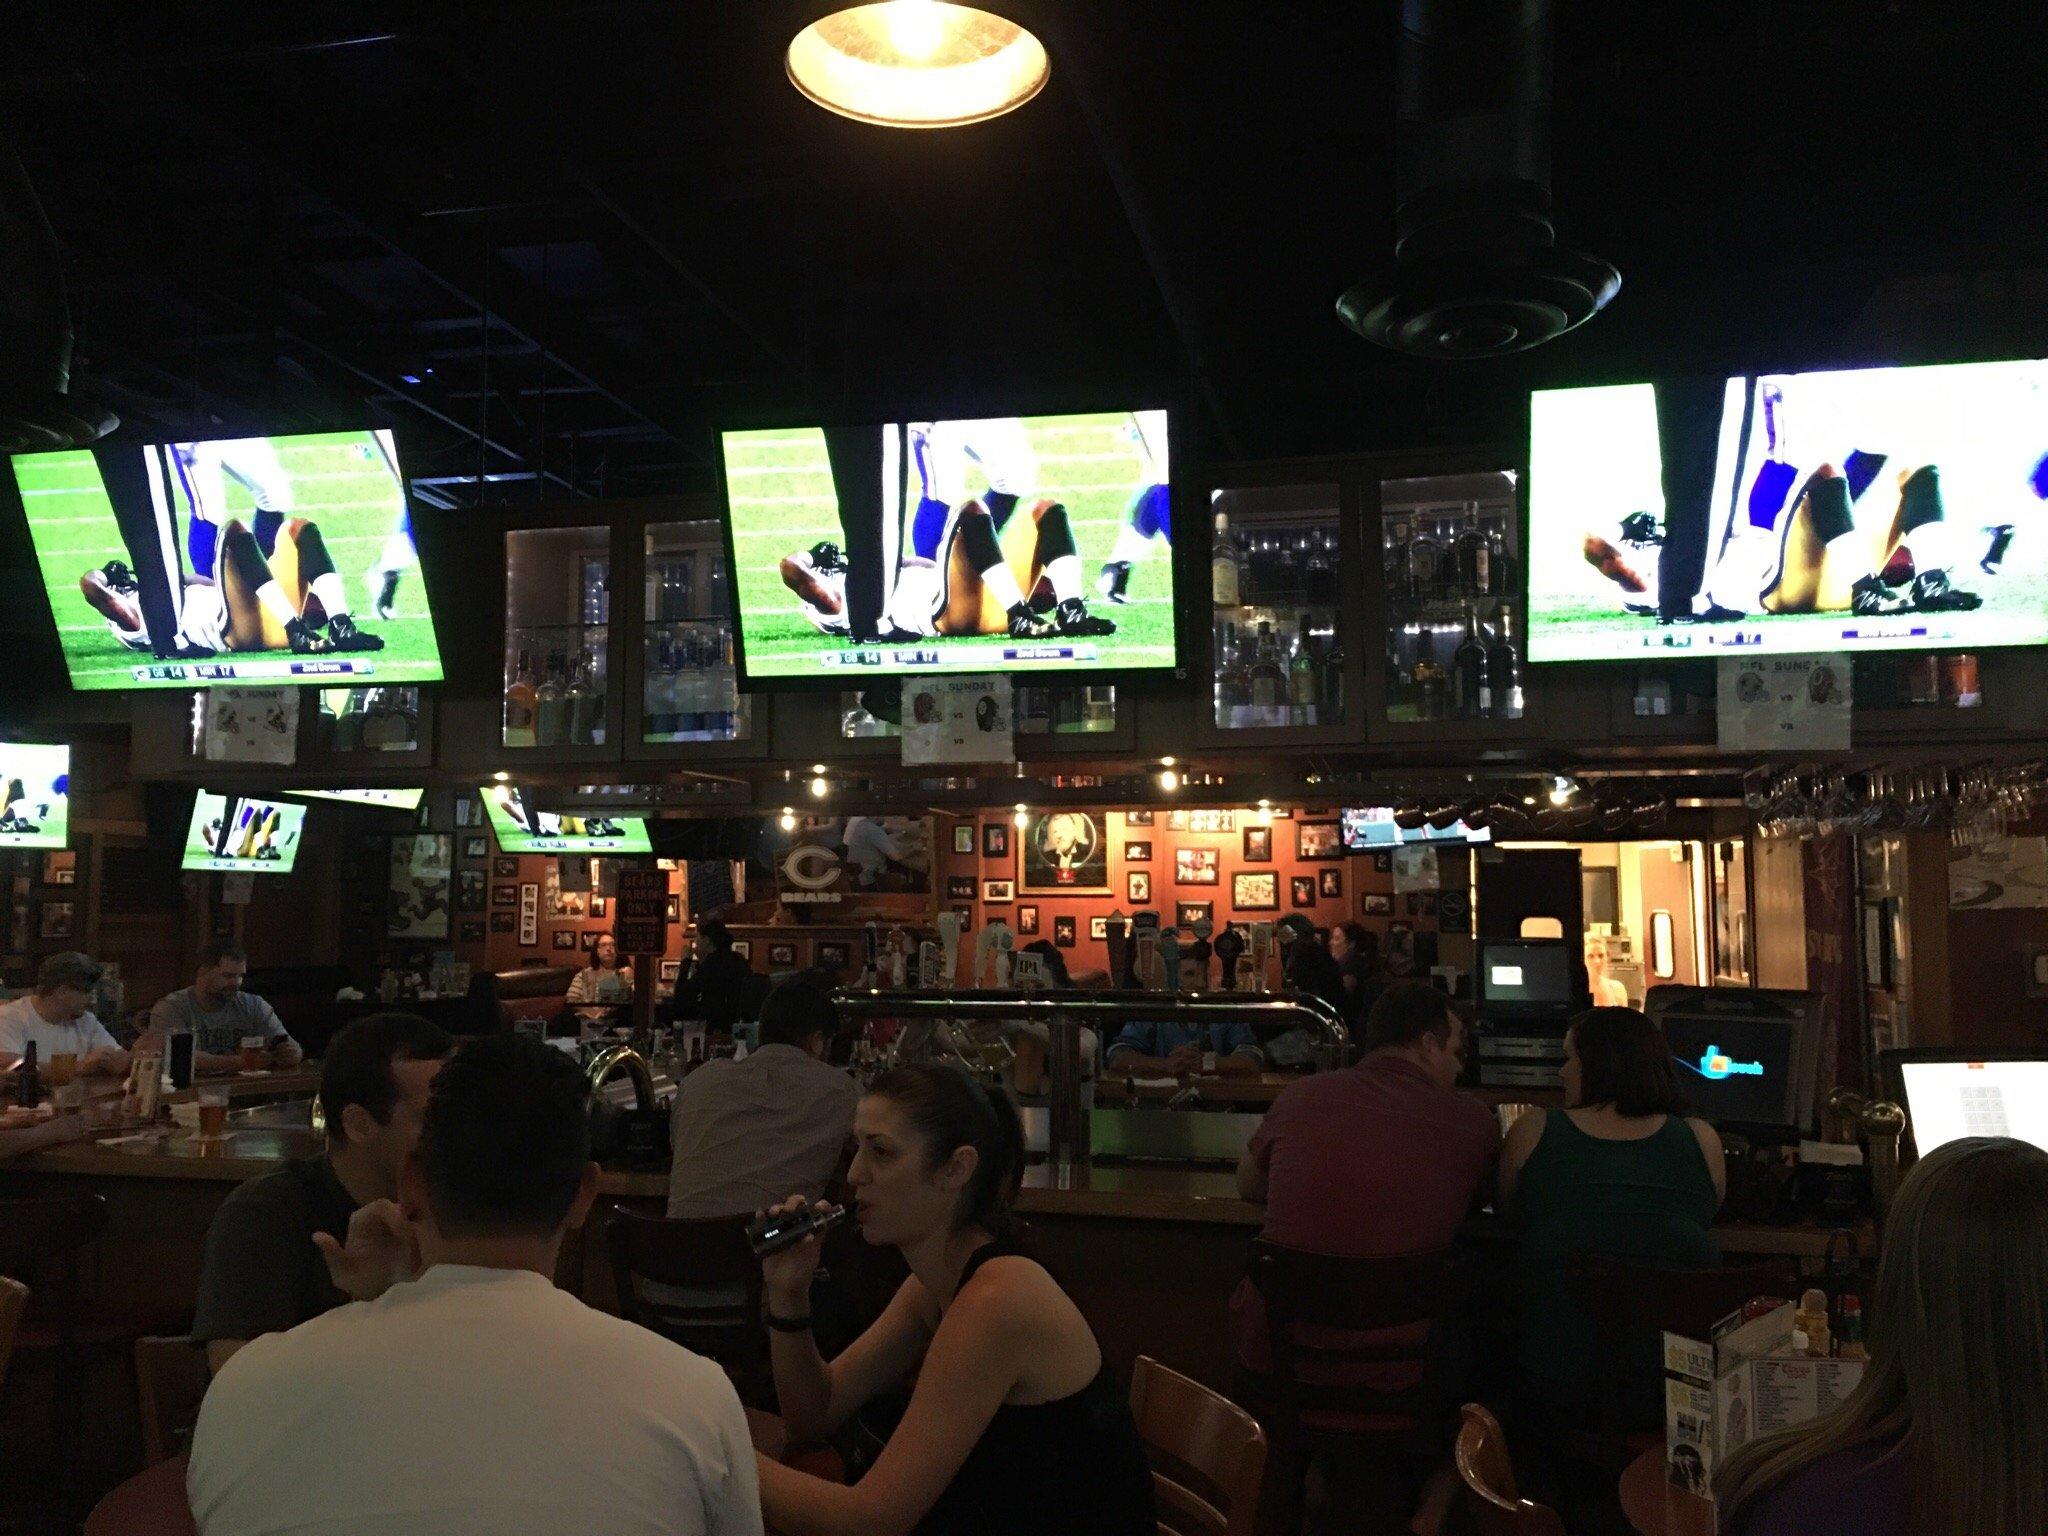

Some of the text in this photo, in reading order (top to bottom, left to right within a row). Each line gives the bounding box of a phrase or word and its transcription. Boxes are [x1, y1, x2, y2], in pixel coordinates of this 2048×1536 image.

[1740, 661, 1766, 671] NFL
[152, 666, 166, 678] GB
[948, 681, 996, 691] SUNDAY
[781, 892, 842, 903] BEARS
